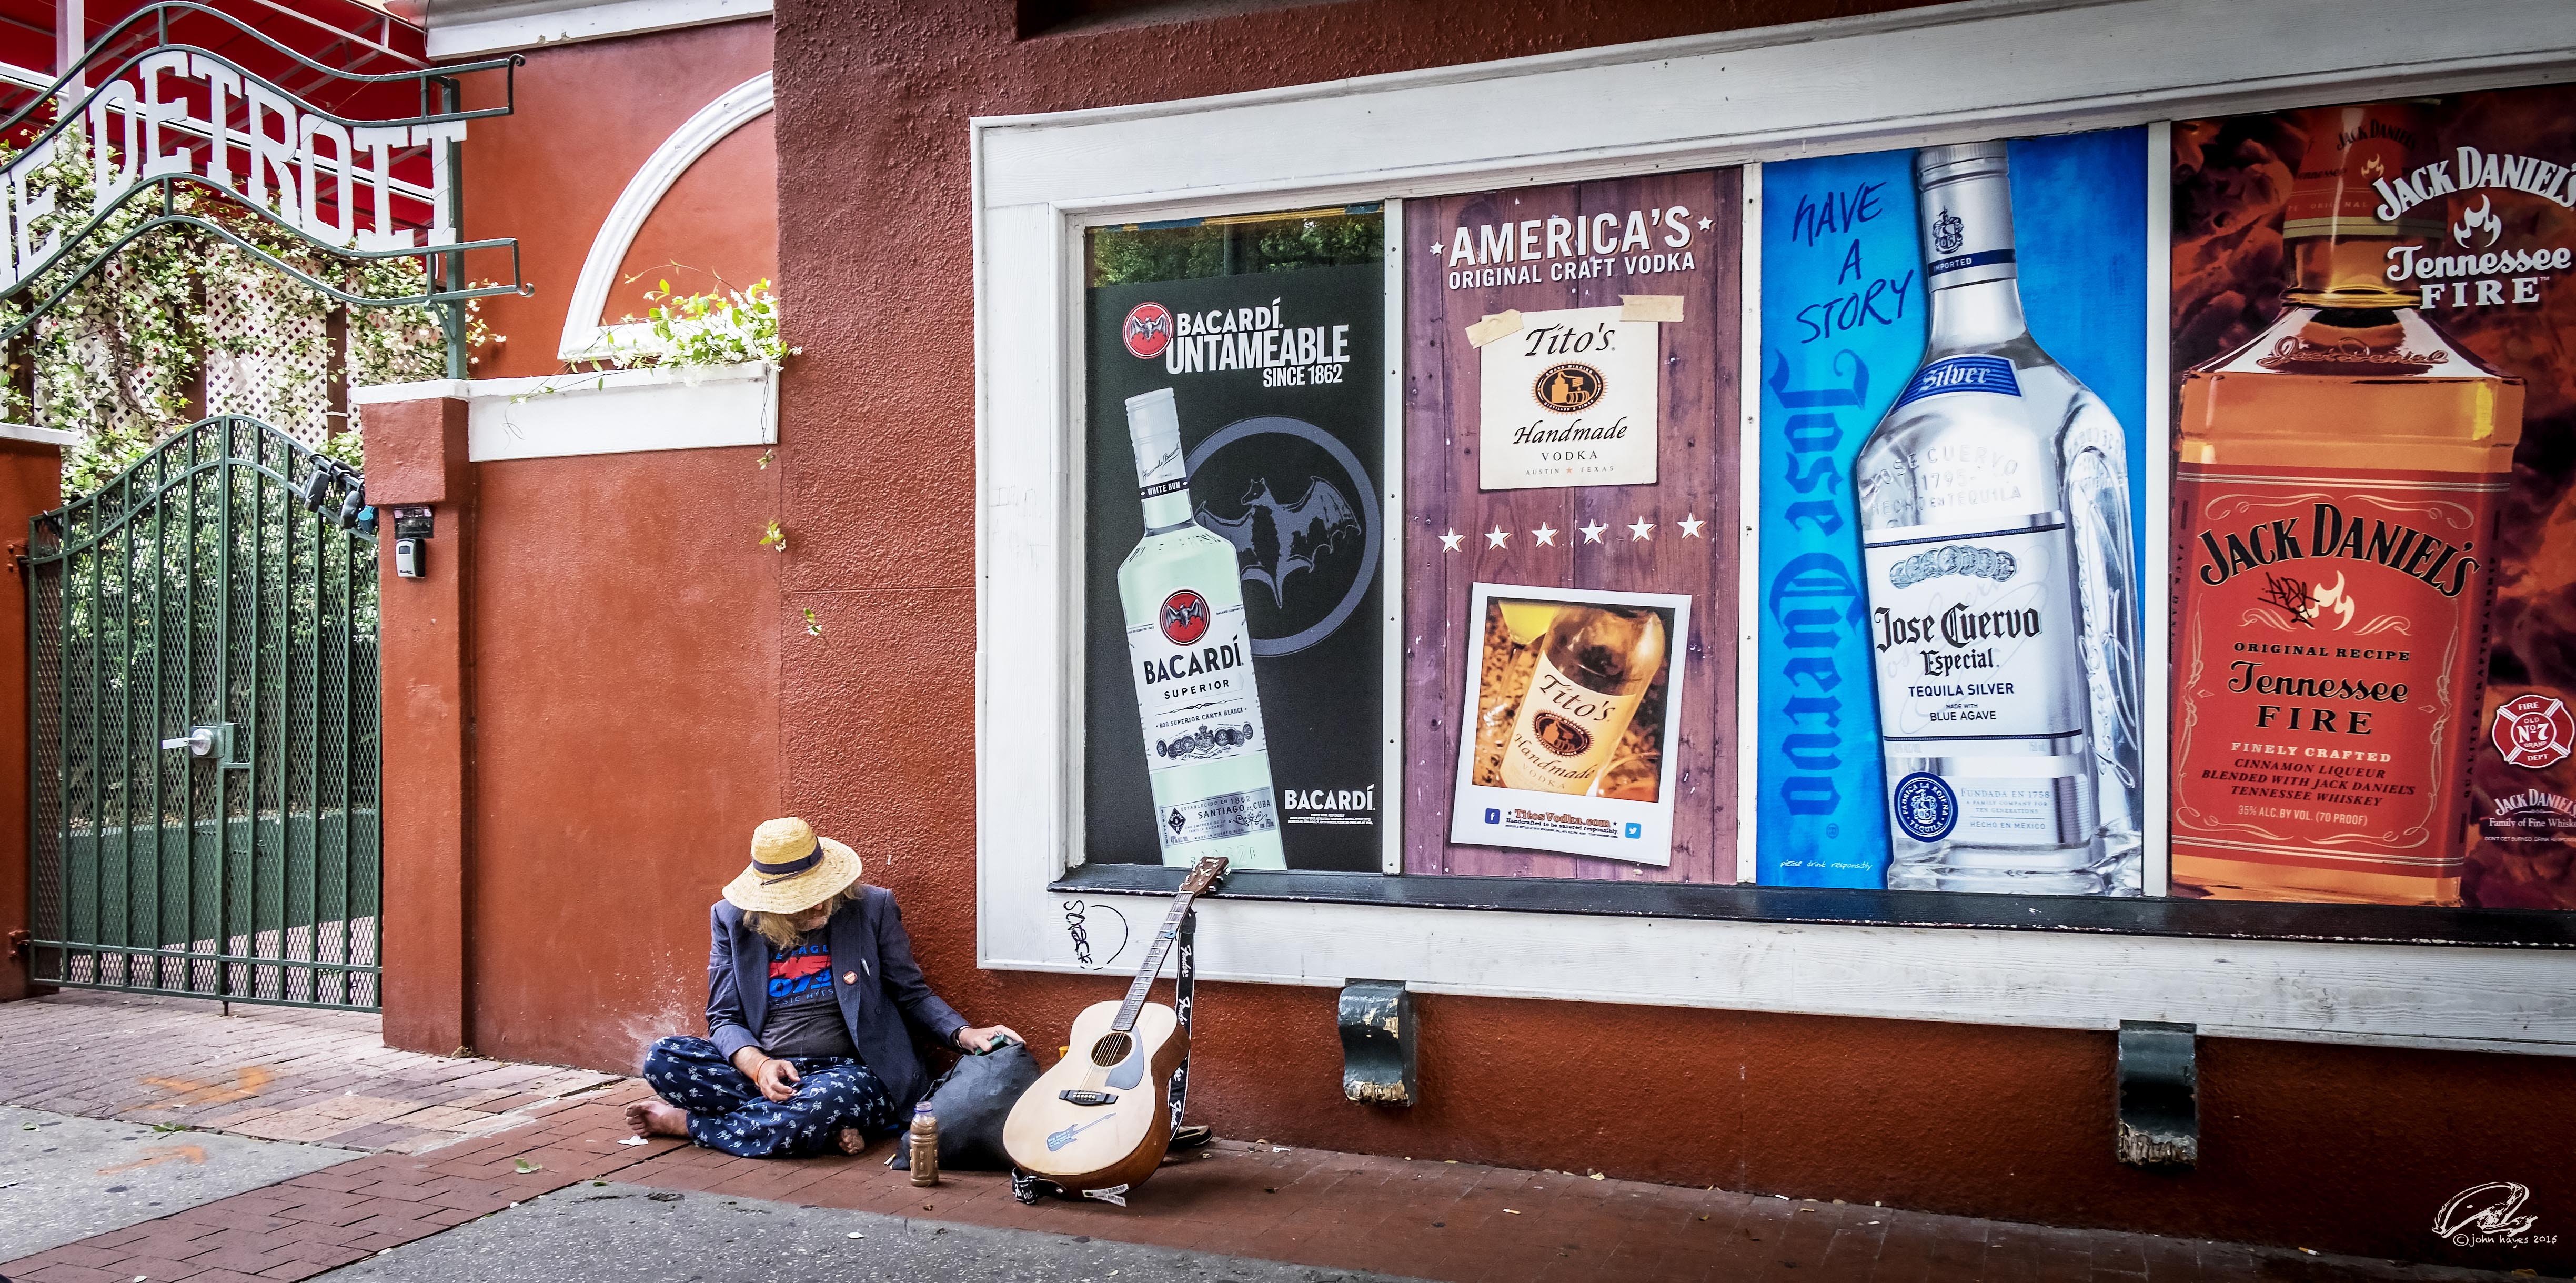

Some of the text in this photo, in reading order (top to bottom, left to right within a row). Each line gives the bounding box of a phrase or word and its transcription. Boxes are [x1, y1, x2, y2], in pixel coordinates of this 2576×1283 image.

[89, 51, 467, 252] DETROIT
[2293, 168, 2347, 181] ennessee
[2372, 160, 2458, 221] JACK
[1448, 206, 1693, 268] AMERICA'S
[1448, 252, 1695, 290] ORIGINAL CRAFT VODKA
[1838, 238, 1863, 286] A
[1933, 257, 1973, 272] IMPORTED
[2386, 246, 2571, 283] Tennessee
[2420, 277, 2541, 309] FIRE
[1177, 296, 1280, 337] BACARDÍ
[1796, 269, 1914, 344] STORY
[1165, 324, 1350, 375] UNTAMEABLE
[1524, 322, 1615, 357] Tito's
[1263, 364, 1343, 387] SINCE 1862
[1919, 363, 1993, 392] Silver
[1513, 416, 1628, 445] Handmade
[1541, 450, 1598, 461] VODKA
[1927, 445, 2018, 476] CUERVO
[1147, 481, 1181, 496] WHITE RUM
[1947, 486, 2021, 505] TEQUILA
[2199, 502, 2482, 599] JACK DANIEL'S
[1768, 348, 1870, 816] Jose Cuervo
[1874, 602, 2042, 653] Jose Cuervo
[1143, 633, 1241, 685] BACARDÍ
[1919, 648, 1993, 677] Especial
[2233, 642, 2411, 662] ORIGINAL RECIPE
[1164, 679, 1230, 699] SUPERIOR
[1908, 683, 2015, 697] TEQUILA SILVER
[2228, 660, 2409, 703] Tennessee
[1539, 674, 1616, 721] Tito's
[2518, 701, 2540, 710] FIRE
[1170, 716, 1200, 726] SUPERIOR
[1202, 711, 1222, 720] CARTA
[1930, 711, 1997, 721] BLUE AGAVE
[2256, 705, 2373, 736] FIRE
[1514, 733, 1598, 779] Handmade
[2231, 742, 2392, 763] FINELY CRAFTED
[1523, 763, 1566, 789] VODKA
[2234, 758, 2386, 779] CINNAMON LIQUEUR
[2028, 790, 2050, 799] 1758
[2201, 770, 2416, 796] BLENDED WITH JACK DANIEL'S
[2231, 785, 2383, 807] TENNESSEE WHISKEY
[1181, 801, 1219, 811] ESTABLECIDO
[1230, 795, 1251, 805] 1862
[1198, 804, 1244, 819] SANTIAGO
[1253, 800, 1271, 810] CUBA
[1284, 783, 1375, 811] BACARDÍ
[2494, 793, 2529, 816] JACK
[1506, 818, 1542, 827] Handcrafted
[1514, 809, 1611, 828] TitosVodka.com
[1909, 819, 1944, 834] TEQUILA
[2238, 805, 2368, 826] 35% ALC. BY VOL. (70 PROOF)
[2489, 817, 2515, 828] Family
[2518, 818, 2526, 827] of
[2528, 818, 2545, 827] Fine
[807, 988, 834, 1000] HITS
